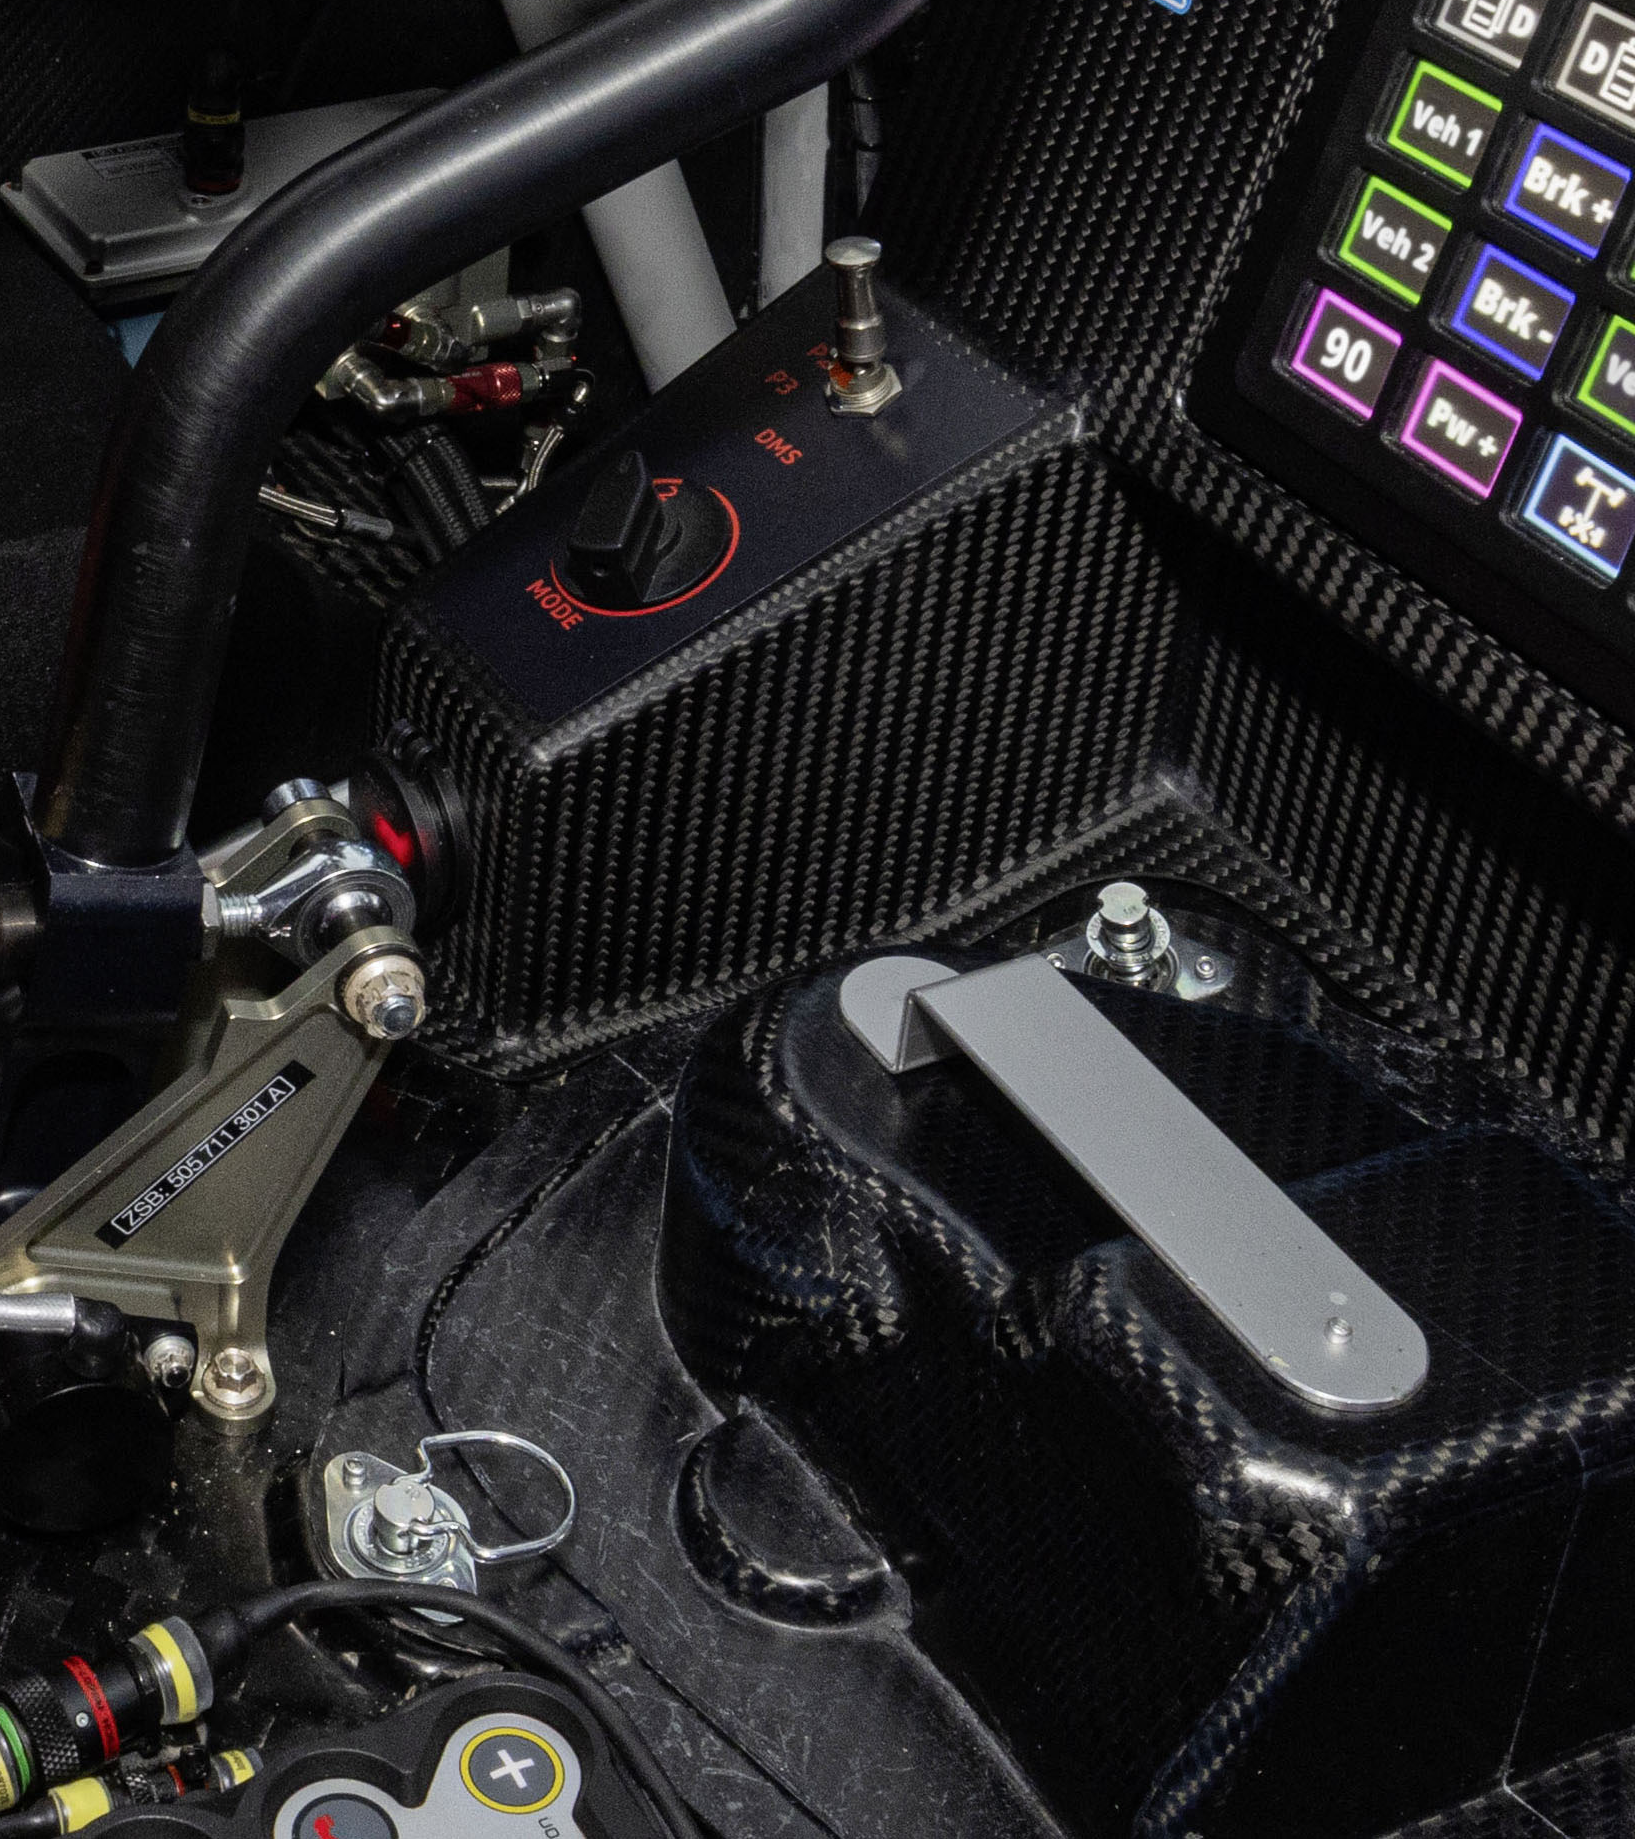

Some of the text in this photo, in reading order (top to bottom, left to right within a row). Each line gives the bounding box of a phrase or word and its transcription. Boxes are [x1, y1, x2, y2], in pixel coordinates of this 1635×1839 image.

[1580, 45, 1607, 74] D
[1413, 100, 1479, 155] Veh 1
[1523, 159, 1586, 209] Brk
[1361, 207, 1433, 273] Veh 2
[1472, 280, 1535, 335] Brk
[1321, 323, 1372, 380] 90
[765, 370, 798, 395] P3
[1427, 399, 1470, 441] Pw
[754, 427, 803, 466] DMS
[526, 579, 583, 631] MODE
[122, 1088, 286, 1226] ZSB: 505 711 301 A
